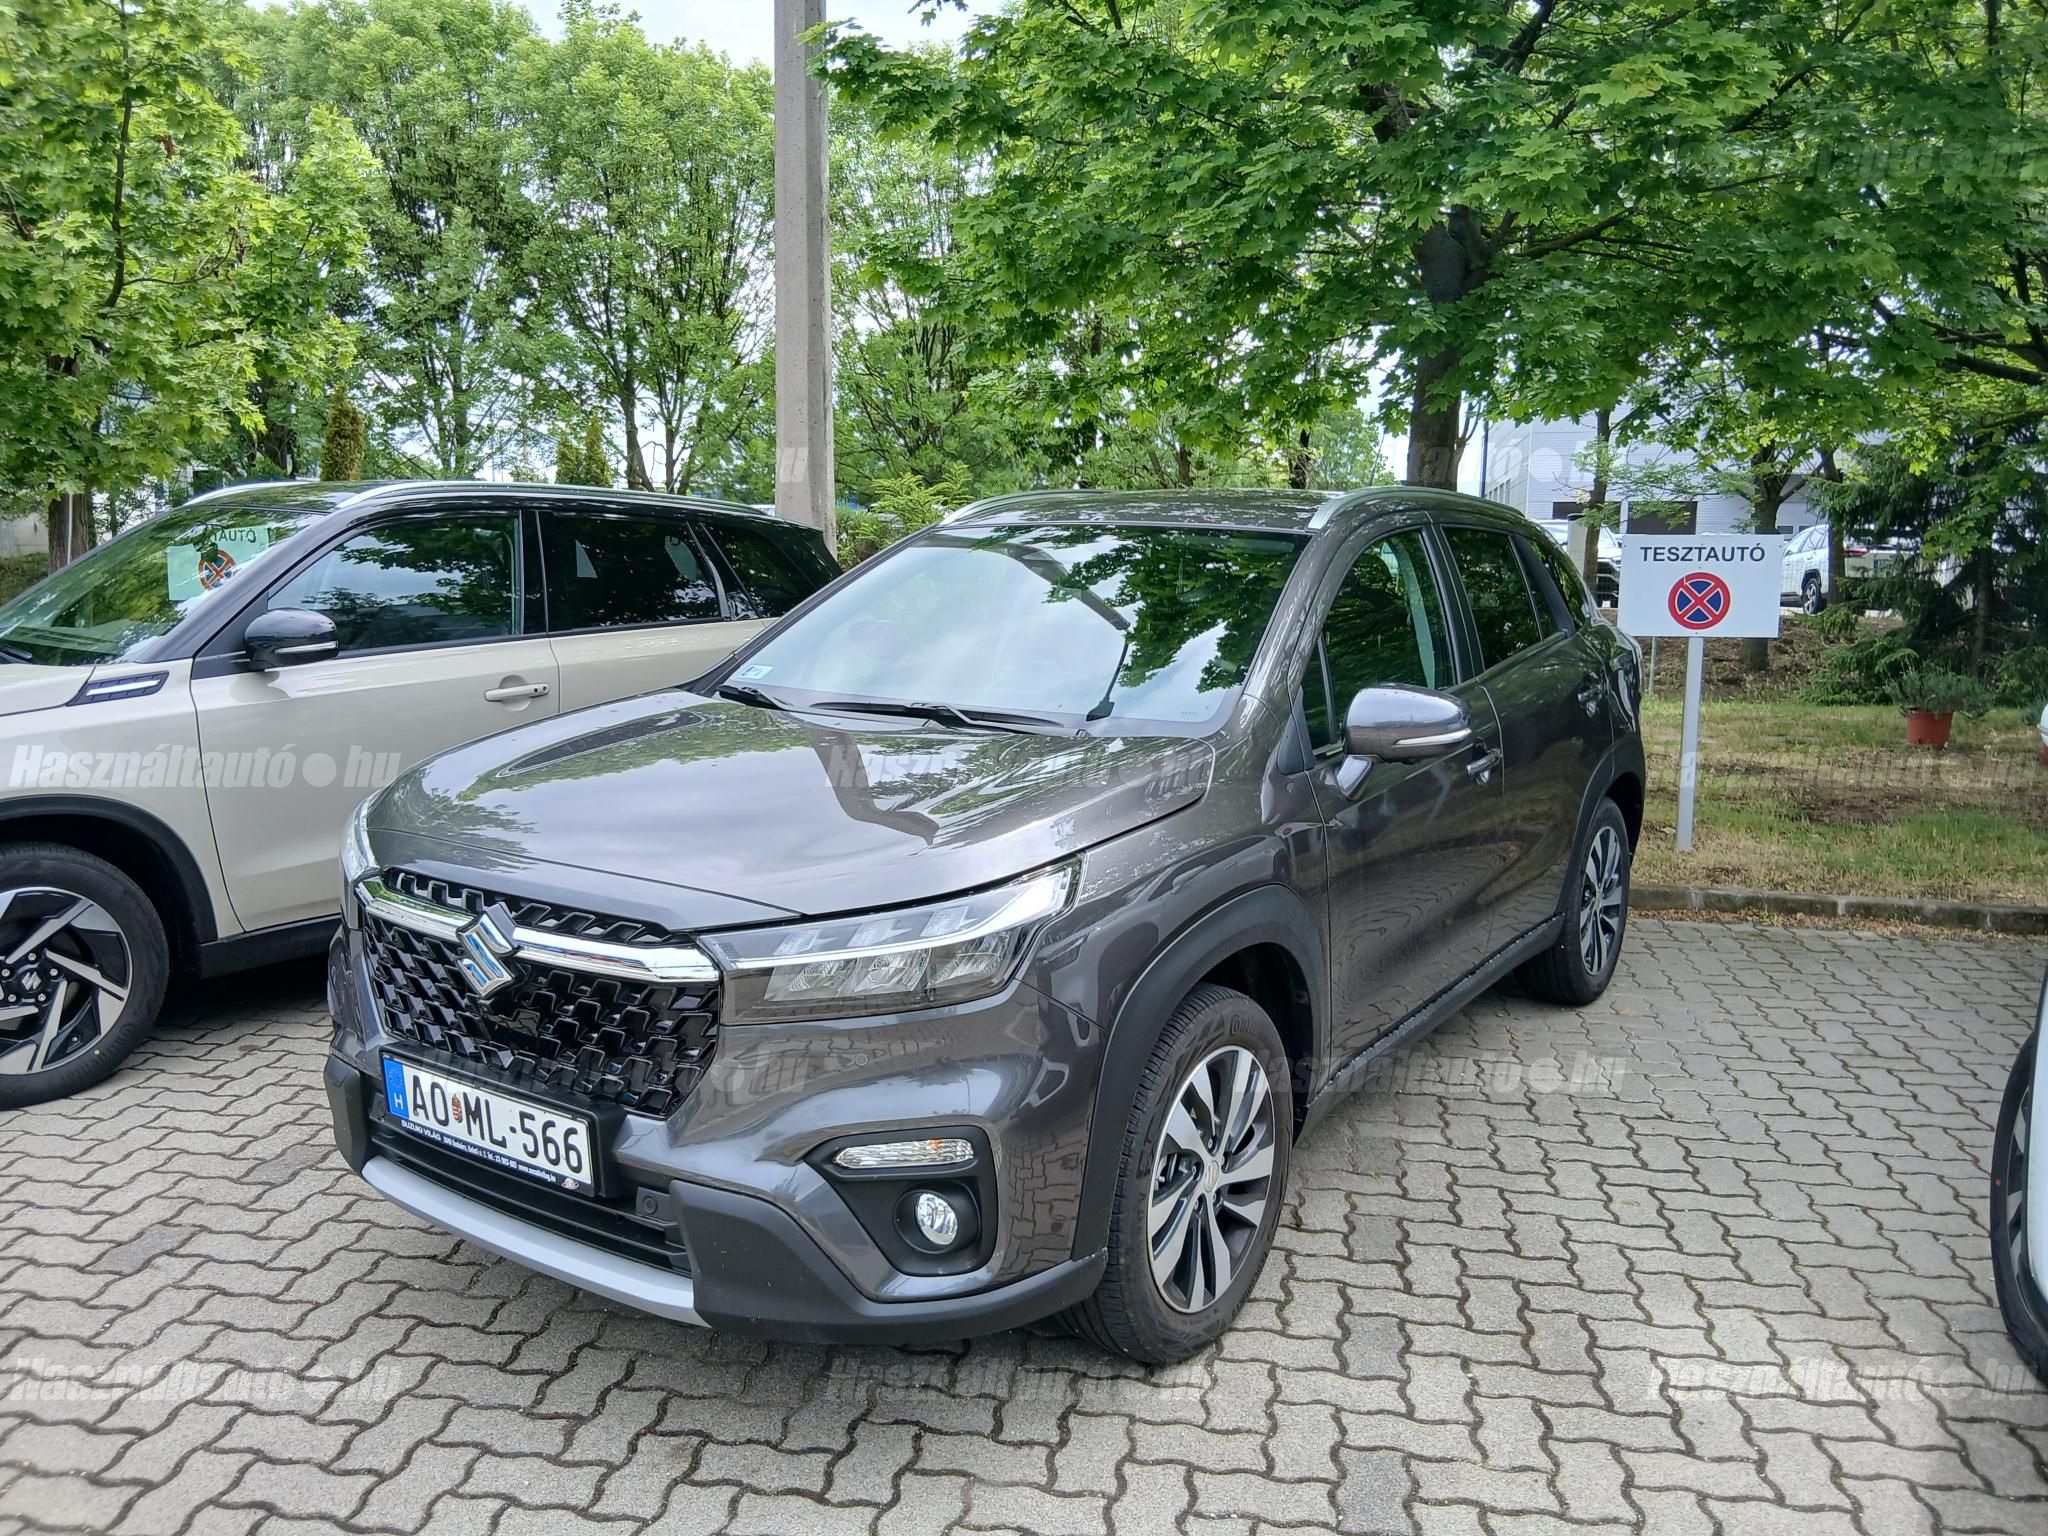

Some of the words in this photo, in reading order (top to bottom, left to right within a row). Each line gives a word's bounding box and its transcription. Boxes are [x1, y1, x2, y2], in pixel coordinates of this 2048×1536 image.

[1640, 543, 1765, 562] TESZTAUTÓ
[393, 1092, 405, 1110] H
[413, 1074, 449, 1127] AO
